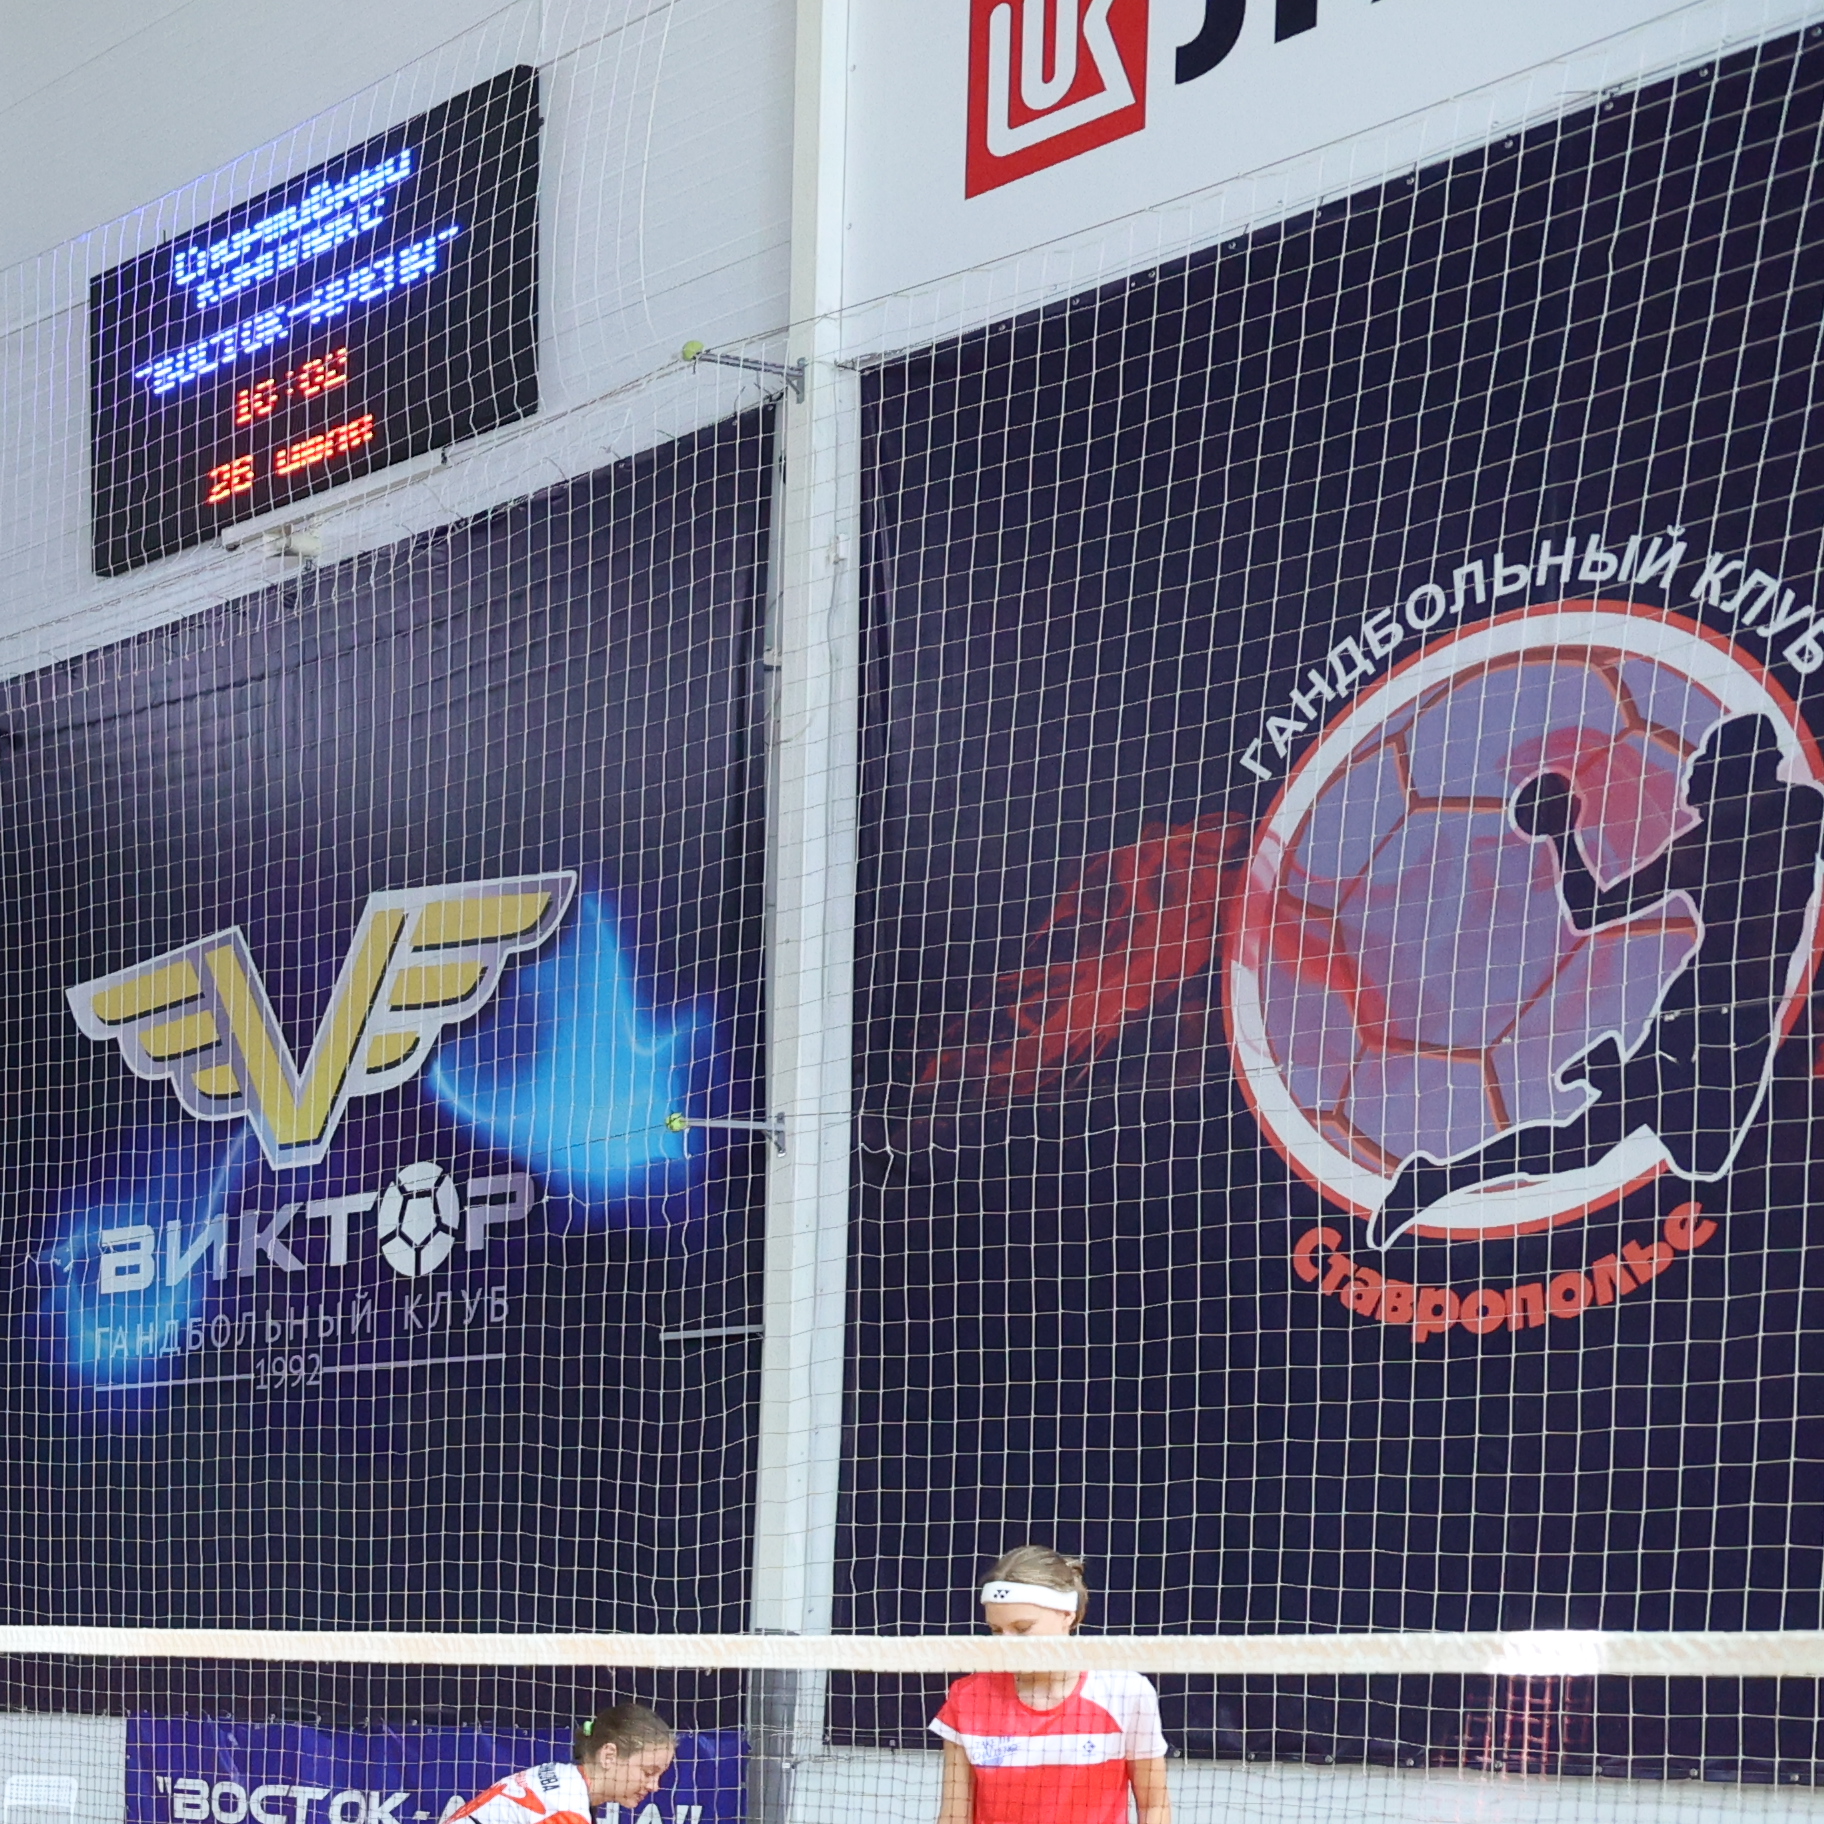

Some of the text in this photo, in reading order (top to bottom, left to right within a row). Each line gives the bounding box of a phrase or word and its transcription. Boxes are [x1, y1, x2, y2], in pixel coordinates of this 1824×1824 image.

[1239, 525, 1824, 782] ГАНДБОЛЬНЫЙ КЛУБ
[94, 1285, 511, 1358] ГАНДБОЛЬНЫЙ КЛУБ
[1292, 1200, 1719, 1344] Ставрополье
[255, 1353, 323, 1391] 1992
